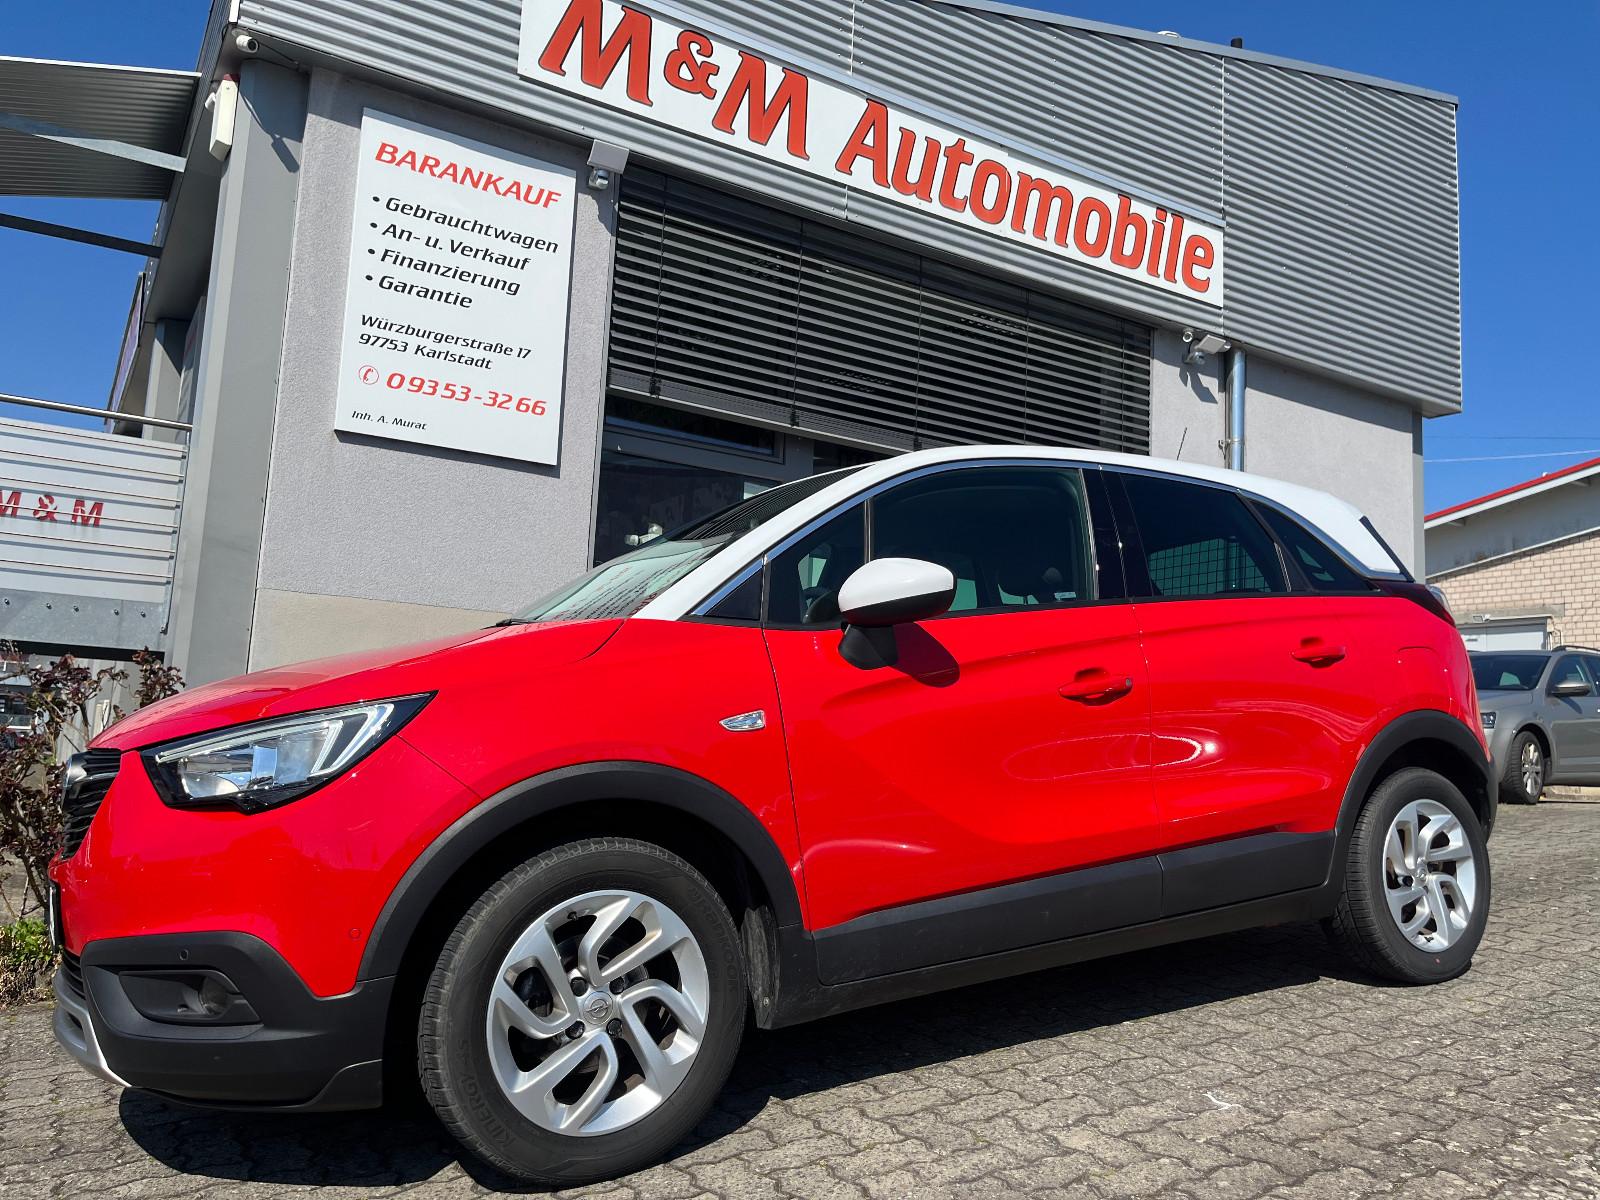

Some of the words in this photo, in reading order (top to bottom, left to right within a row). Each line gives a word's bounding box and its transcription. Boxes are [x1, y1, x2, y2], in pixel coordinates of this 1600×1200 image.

[538, 0, 810, 160] M&M
[835, 97, 1215, 293] Automobile
[375, 142, 562, 208] BARANKAUF
[382, 223, 421, 242] An-
[424, 235, 443, 250] u.
[449, 239, 532, 270] Verkauf
[385, 197, 559, 253] Gebrauchtwagen
[378, 275, 473, 308] Garantie
[380, 248, 521, 296] Finanzierung
[358, 333, 409, 353] 97753
[414, 344, 493, 370] Karlstadt
[361, 314, 513, 356] Würzburgerstraße
[516, 347, 532, 359] 17
[351, 410, 373, 422] Inh.
[377, 415, 388, 424] A.
[392, 417, 428, 431] Murat
[33, 494, 57, 522] &
[71, 499, 104, 527] M
